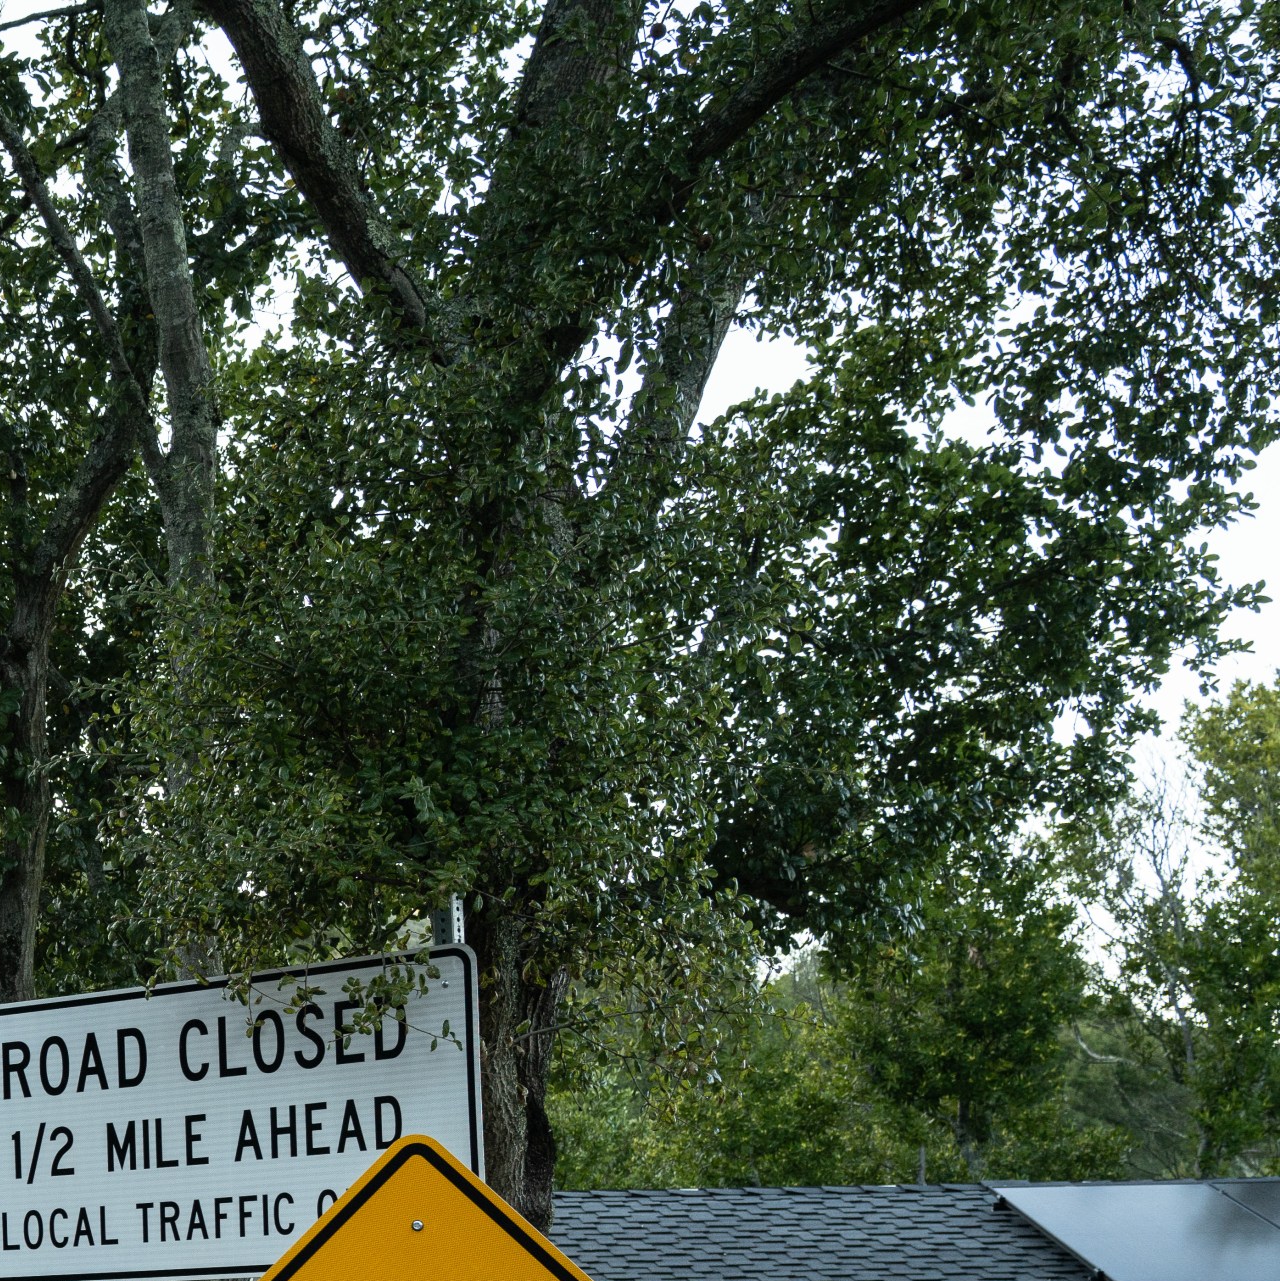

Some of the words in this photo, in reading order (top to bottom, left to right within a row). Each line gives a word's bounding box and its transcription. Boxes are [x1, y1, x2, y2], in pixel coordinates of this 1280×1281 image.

[1, 1026, 149, 1100] ROAD
[178, 996, 409, 1082] CLOSED
[10, 1121, 76, 1185] 1/2
[105, 1113, 210, 1173] MILE
[234, 1094, 403, 1163] AHEAD
[1, 1204, 120, 1251] LOCAL
[135, 1190, 296, 1244] TRAFFIC
